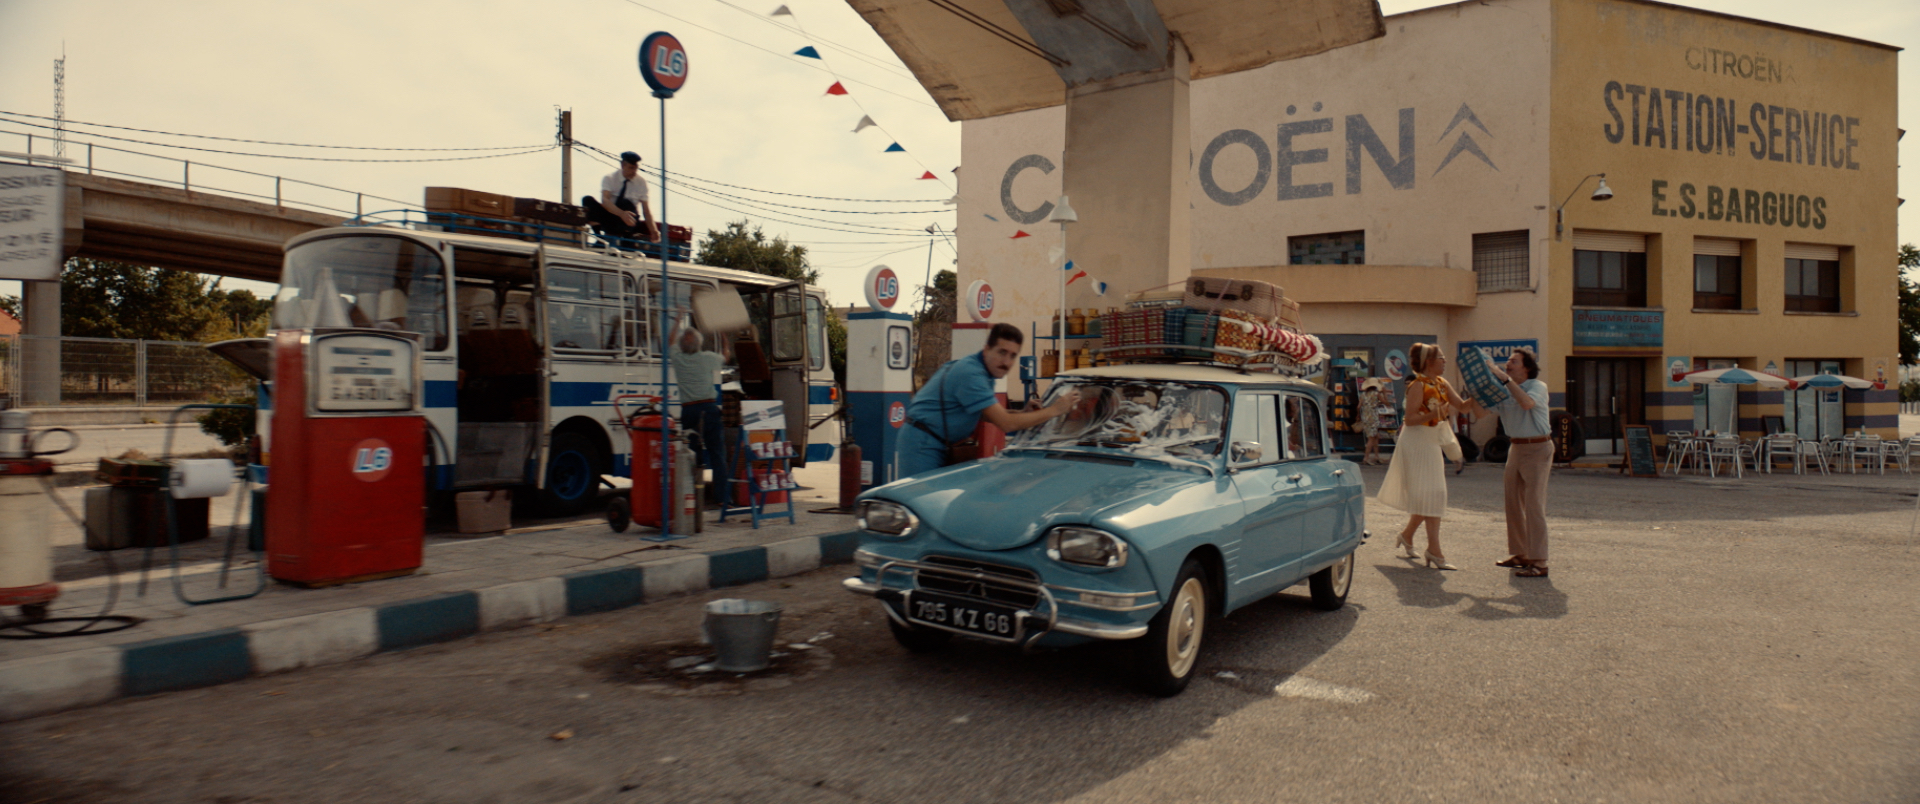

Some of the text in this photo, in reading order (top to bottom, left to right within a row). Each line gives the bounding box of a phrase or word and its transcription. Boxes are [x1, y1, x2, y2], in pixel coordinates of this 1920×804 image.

[654, 44, 687, 78] L6
[1685, 46, 1782, 83] CITROËN
[1603, 80, 1861, 171] STATION-SERVICE
[1000, 101, 1415, 225] COËN
[1652, 179, 1827, 230] E.S.BARGUOS
[878, 276, 898, 300] L6
[978, 291, 993, 312] L6
[1577, 314, 1660, 323] PNEUMATIQUES
[890, 406, 905, 423] L6
[1561, 418, 1569, 457] OUVERT
[353, 447, 392, 473] L6
[916, 601, 947, 622] 795
[953, 607, 980, 630] KZ
